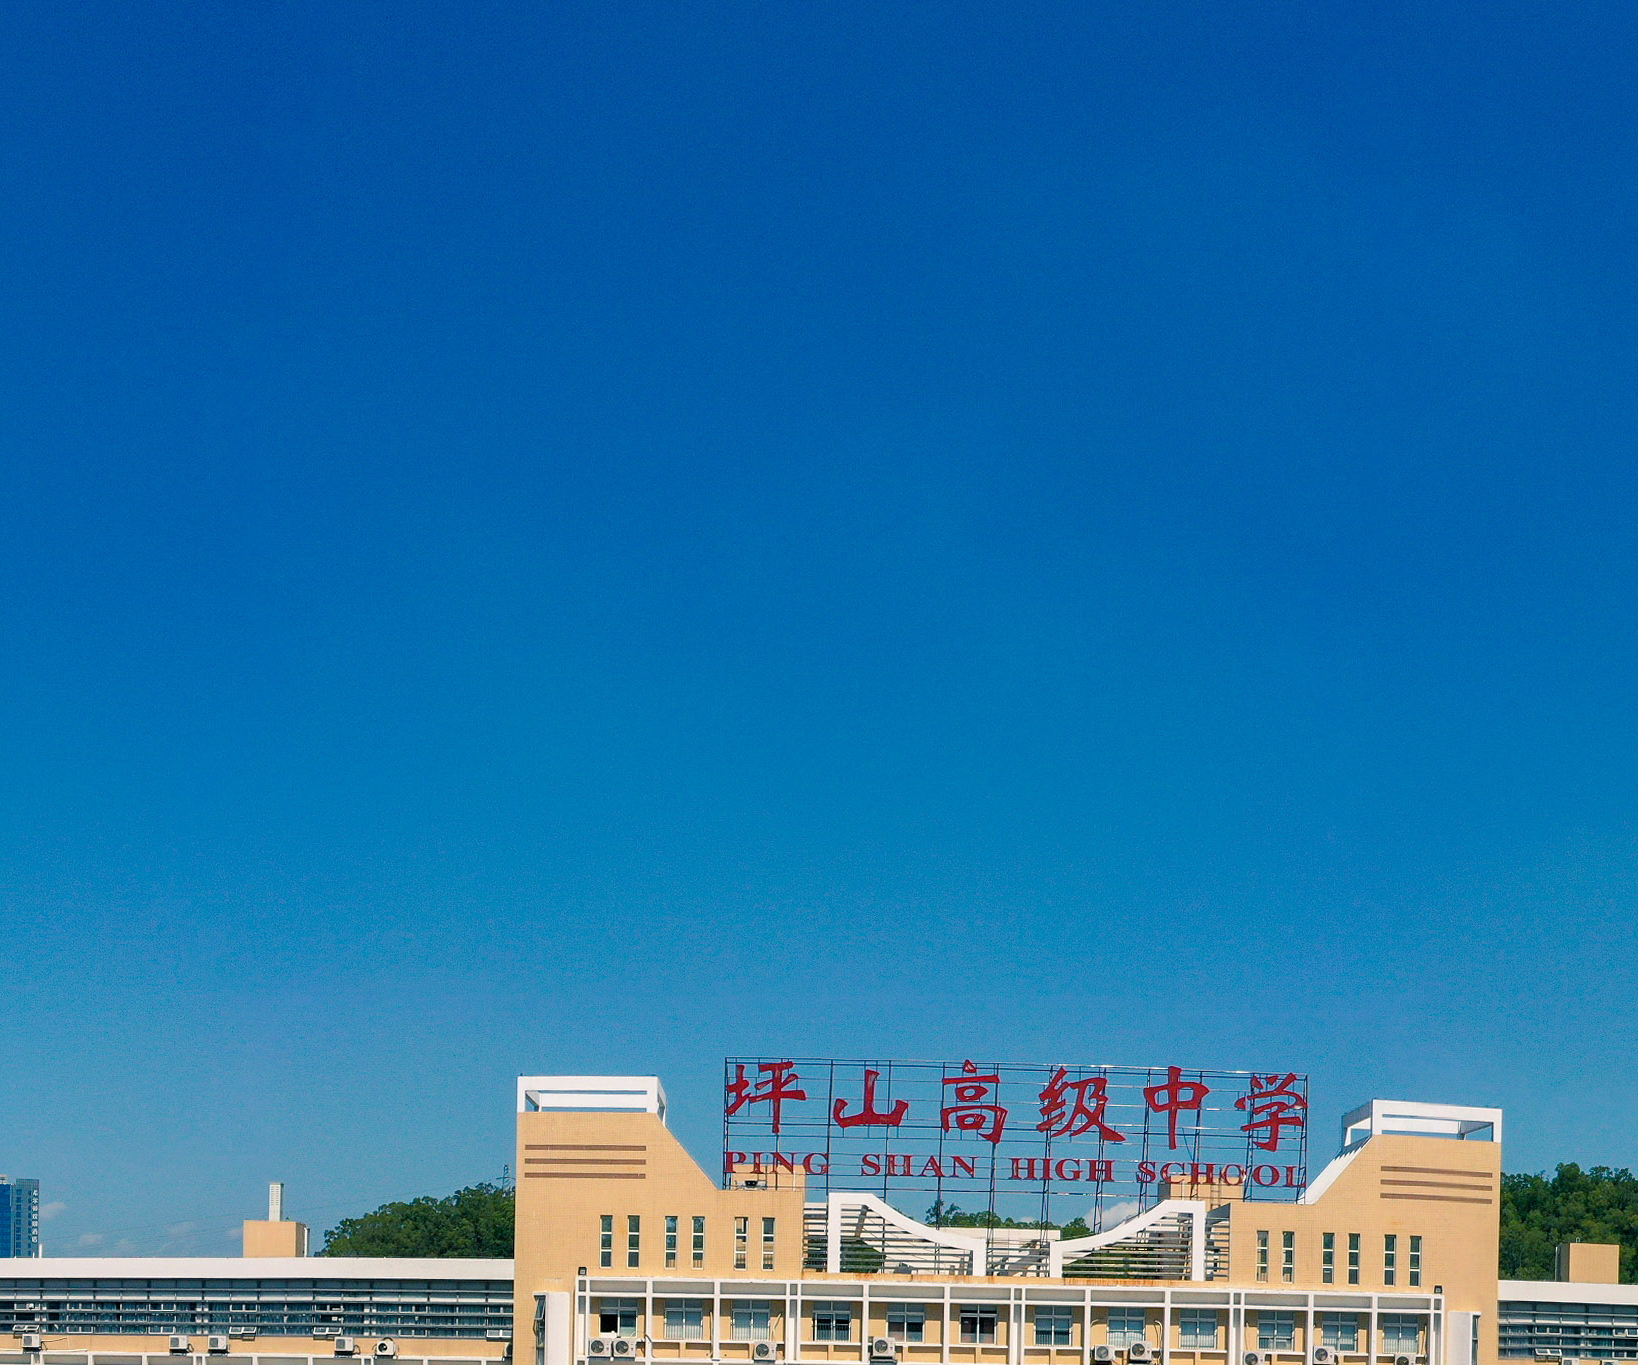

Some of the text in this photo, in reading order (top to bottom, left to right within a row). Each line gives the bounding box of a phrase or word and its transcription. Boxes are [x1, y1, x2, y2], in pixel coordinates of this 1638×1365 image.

[726, 1059, 1308, 1152] 坪山高级中学
[726, 1152, 1307, 1188] PING SHAN HIGH SCHOOL
